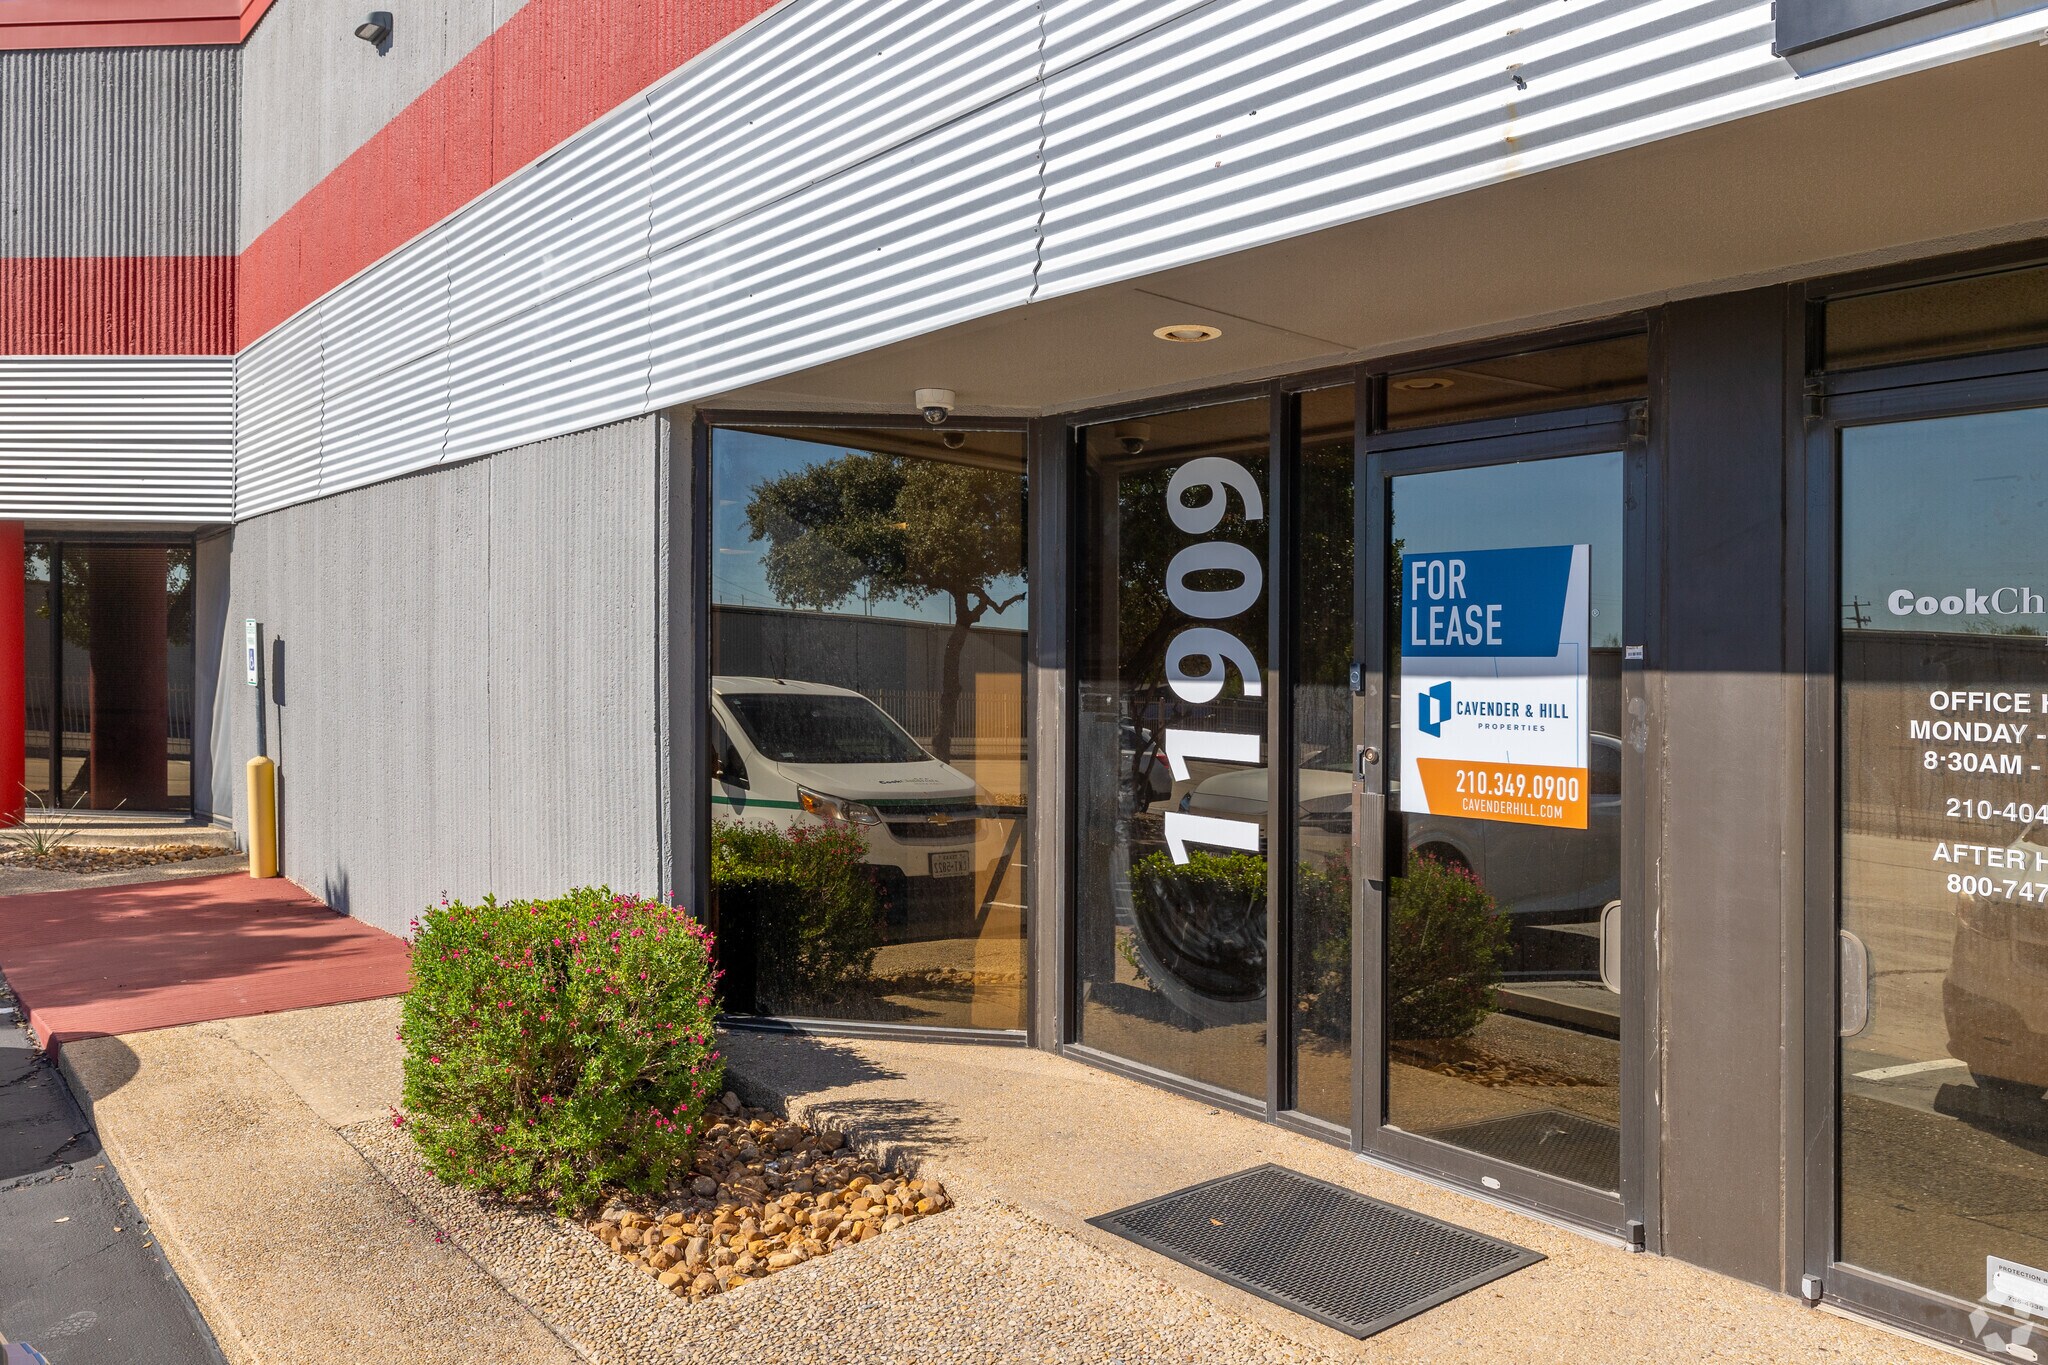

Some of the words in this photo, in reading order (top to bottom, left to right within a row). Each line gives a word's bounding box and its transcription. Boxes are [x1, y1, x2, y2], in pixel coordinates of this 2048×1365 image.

[1411, 559, 1467, 601] FOR
[1887, 586, 2046, 616] CookCh
[1411, 604, 1503, 646] LEASE
[1164, 456, 1264, 865] 11909
[1456, 700, 1520, 717] CAVENDER
[1525, 704, 1534, 718] &
[1539, 703, 1569, 719] HILL
[1929, 690, 2032, 714] OFFICE
[1478, 722, 1546, 732] PROPERTIES
[1910, 719, 2029, 744] MONDAY
[1456, 769, 1579, 802] 210.349.0900
[1462, 797, 1563, 819] CAVENDERHILL.COM
[1932, 842, 2027, 870] AFTER
[1998, 1265, 2041, 1282] PROTECTION
